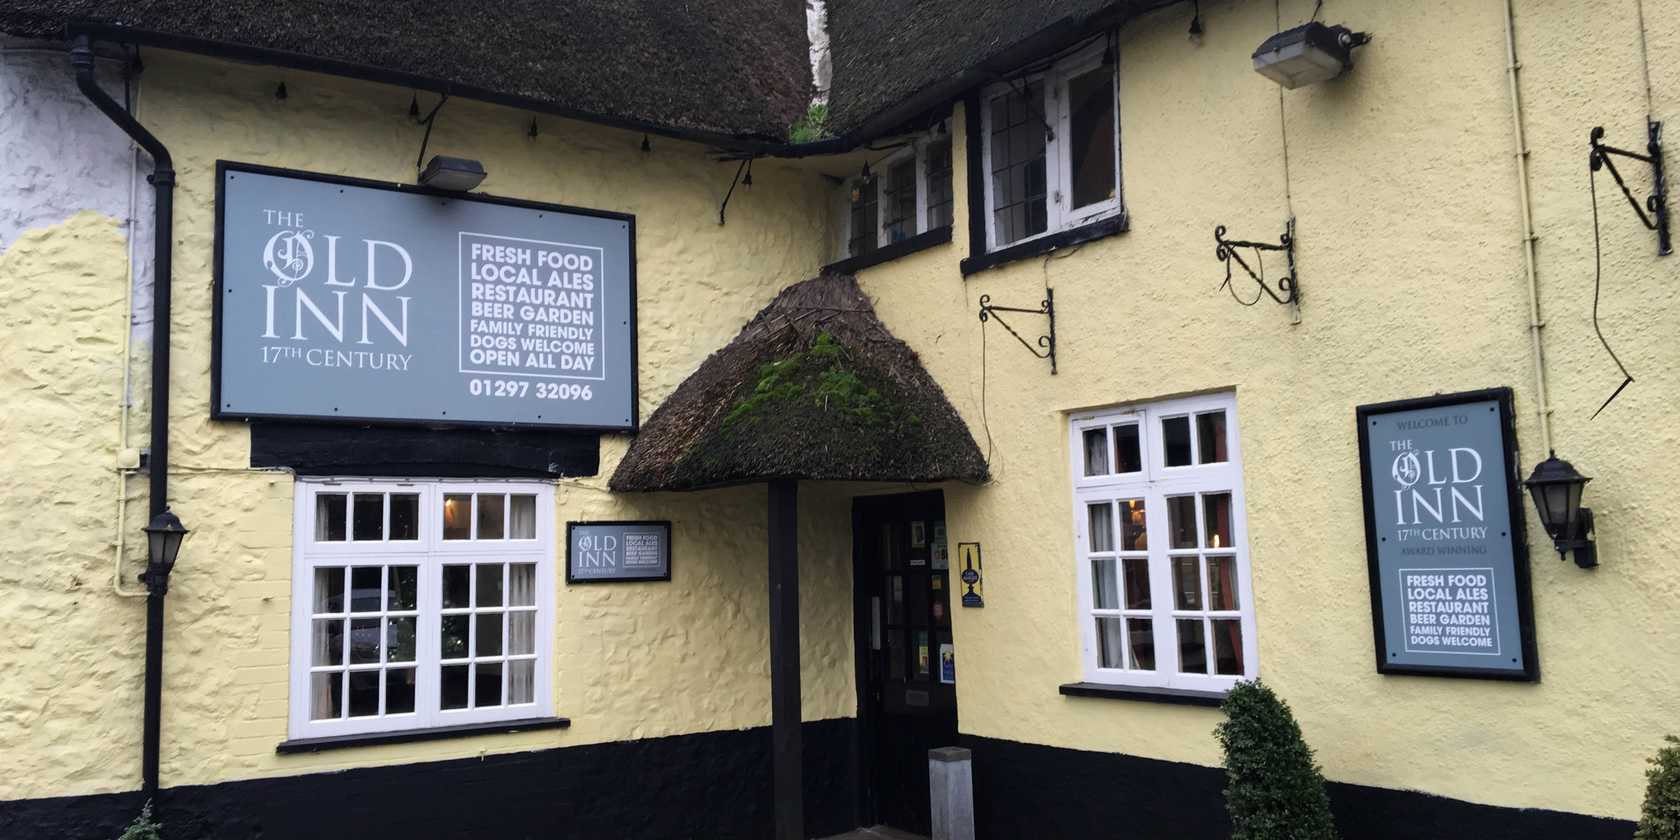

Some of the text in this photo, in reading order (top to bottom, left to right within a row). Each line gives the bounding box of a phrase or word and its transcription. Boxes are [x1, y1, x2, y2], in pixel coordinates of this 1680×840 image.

[263, 209, 304, 228] THE
[263, 229, 413, 290] OLD
[471, 244, 592, 271] FRESH FOOD
[471, 262, 594, 290] LOCAL ALES
[471, 282, 594, 309] RESTAURANT
[261, 284, 413, 347] INN
[472, 302, 594, 326] BEER GARDEN
[470, 320, 593, 340] FAMILY FRIENDLY
[470, 334, 594, 355] DOGS WELCOME
[262, 346, 413, 370] 17TH CENTURY
[470, 350, 594, 371] OPEN ALL DAY
[470, 379, 592, 400] 01297 32096
[1397, 416, 1468, 430] WELCOME TO
[1390, 440, 1413, 451] THE
[1392, 448, 1482, 490] OLD
[1393, 485, 1484, 525] INN
[578, 535, 617, 551] OLD
[1398, 527, 1488, 541] 17TH CENTURY
[579, 551, 616, 567] INN
[1402, 546, 1487, 555] AWARD WINNING
[1407, 575, 1486, 586] FRESH FOOD
[1408, 588, 1488, 600] LOCAL ALES
[1409, 601, 1488, 613] RESTAURANT
[1410, 614, 1490, 625] BEER GARDEN
[1410, 626, 1490, 636] FAMILY FRIENDLY
[1411, 636, 1492, 647] DOGS WELCOME
